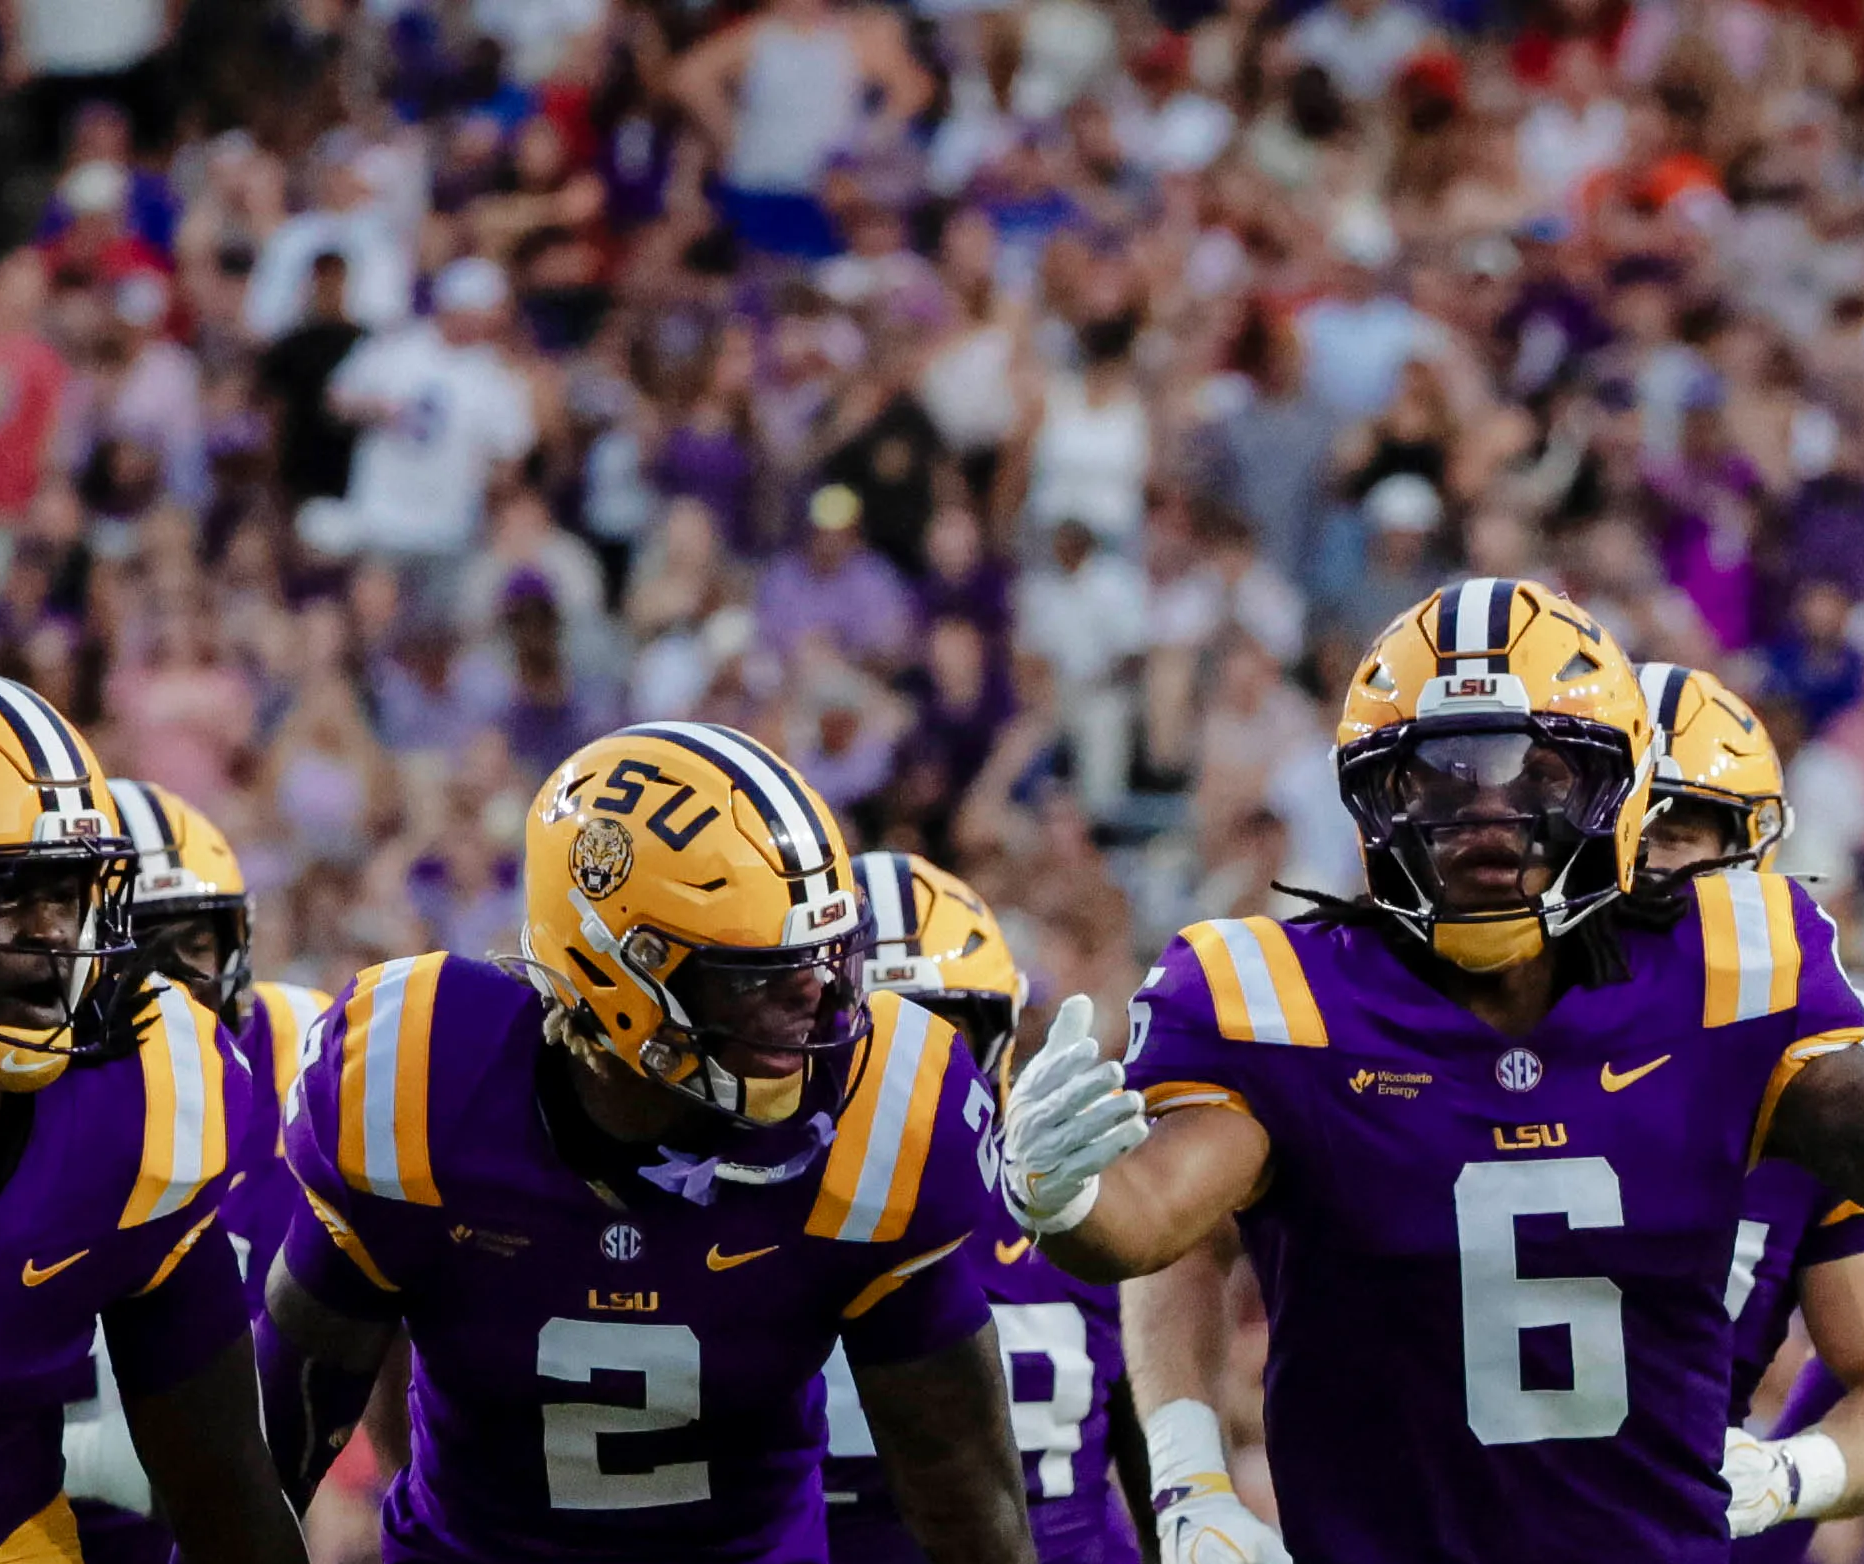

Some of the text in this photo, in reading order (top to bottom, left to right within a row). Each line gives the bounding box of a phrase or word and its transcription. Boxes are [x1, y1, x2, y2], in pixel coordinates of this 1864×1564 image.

[1444, 678, 1498, 698] LSU
[59, 817, 101, 838] LSU
[806, 898, 846, 931] LSU
[1377, 1070, 1434, 1085] Woodside
[1499, 1050, 1540, 1091] SEC
[1377, 1083, 1420, 1100] Energy
[1492, 1122, 1569, 1151] LSU
[601, 1225, 642, 1261] SEC
[588, 1289, 659, 1312] LSU
[1452, 1155, 1629, 1446] 6
[537, 1315, 712, 1510] 2
